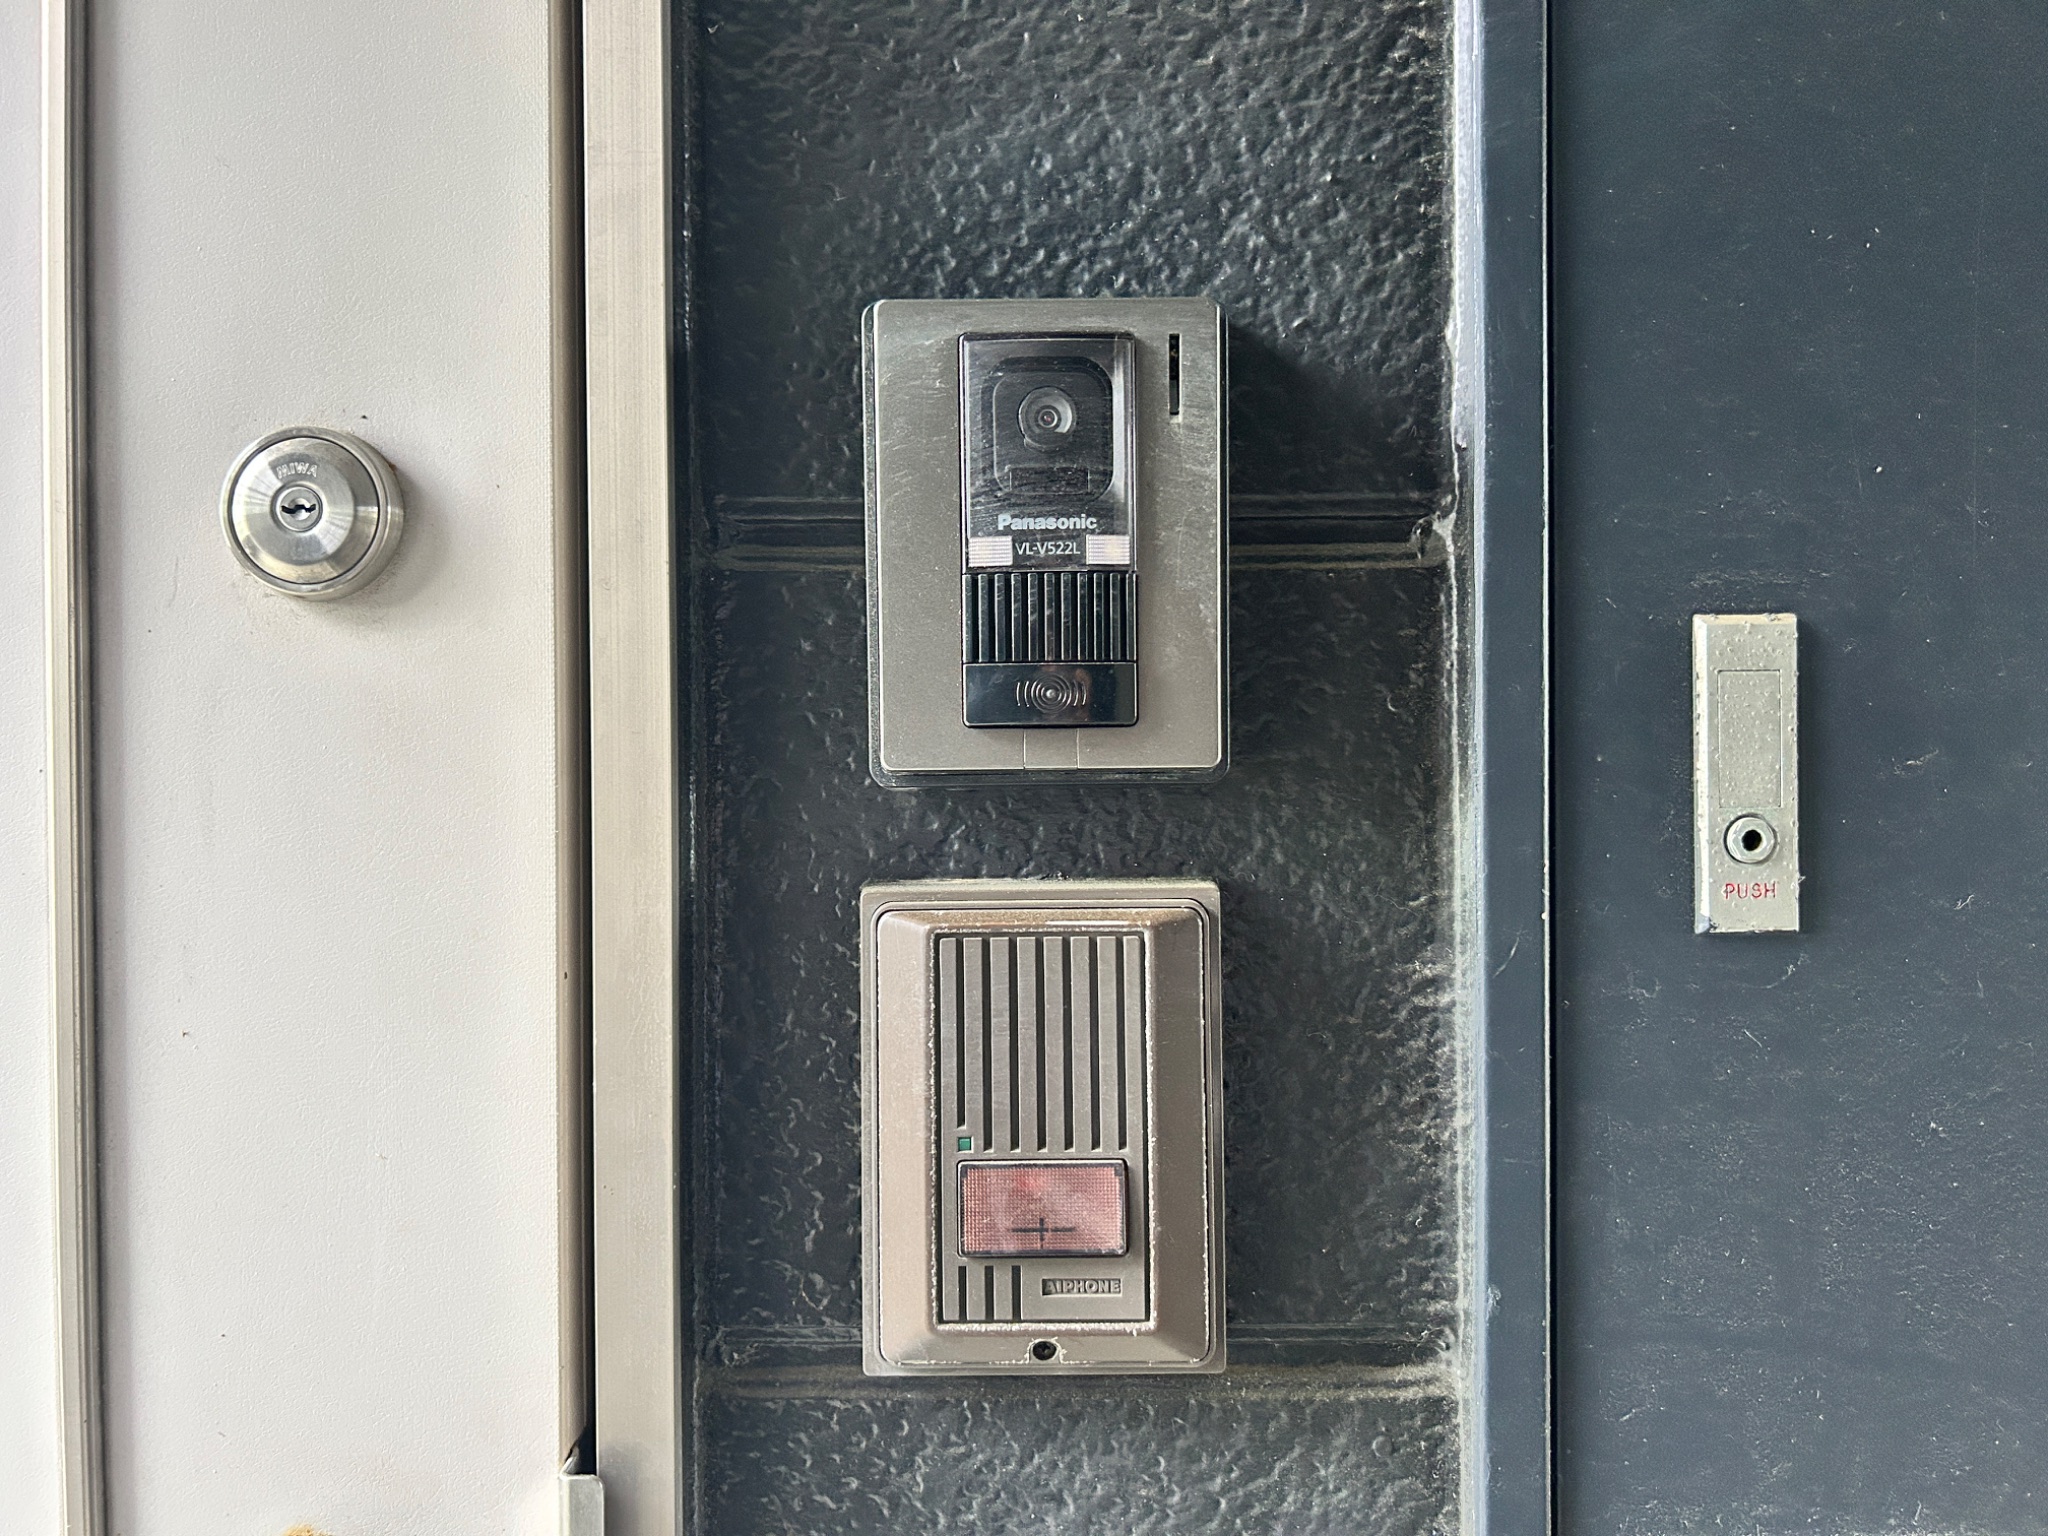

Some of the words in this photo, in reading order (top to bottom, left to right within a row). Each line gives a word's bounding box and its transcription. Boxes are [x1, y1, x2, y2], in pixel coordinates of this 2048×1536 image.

[276, 461, 318, 479] MIWA
[997, 514, 1098, 531] Panasonic
[1016, 541, 1081, 556] VL-V522L
[1725, 882, 1776, 899] PUSH
[1043, 1280, 1122, 1294] AIPHONE
